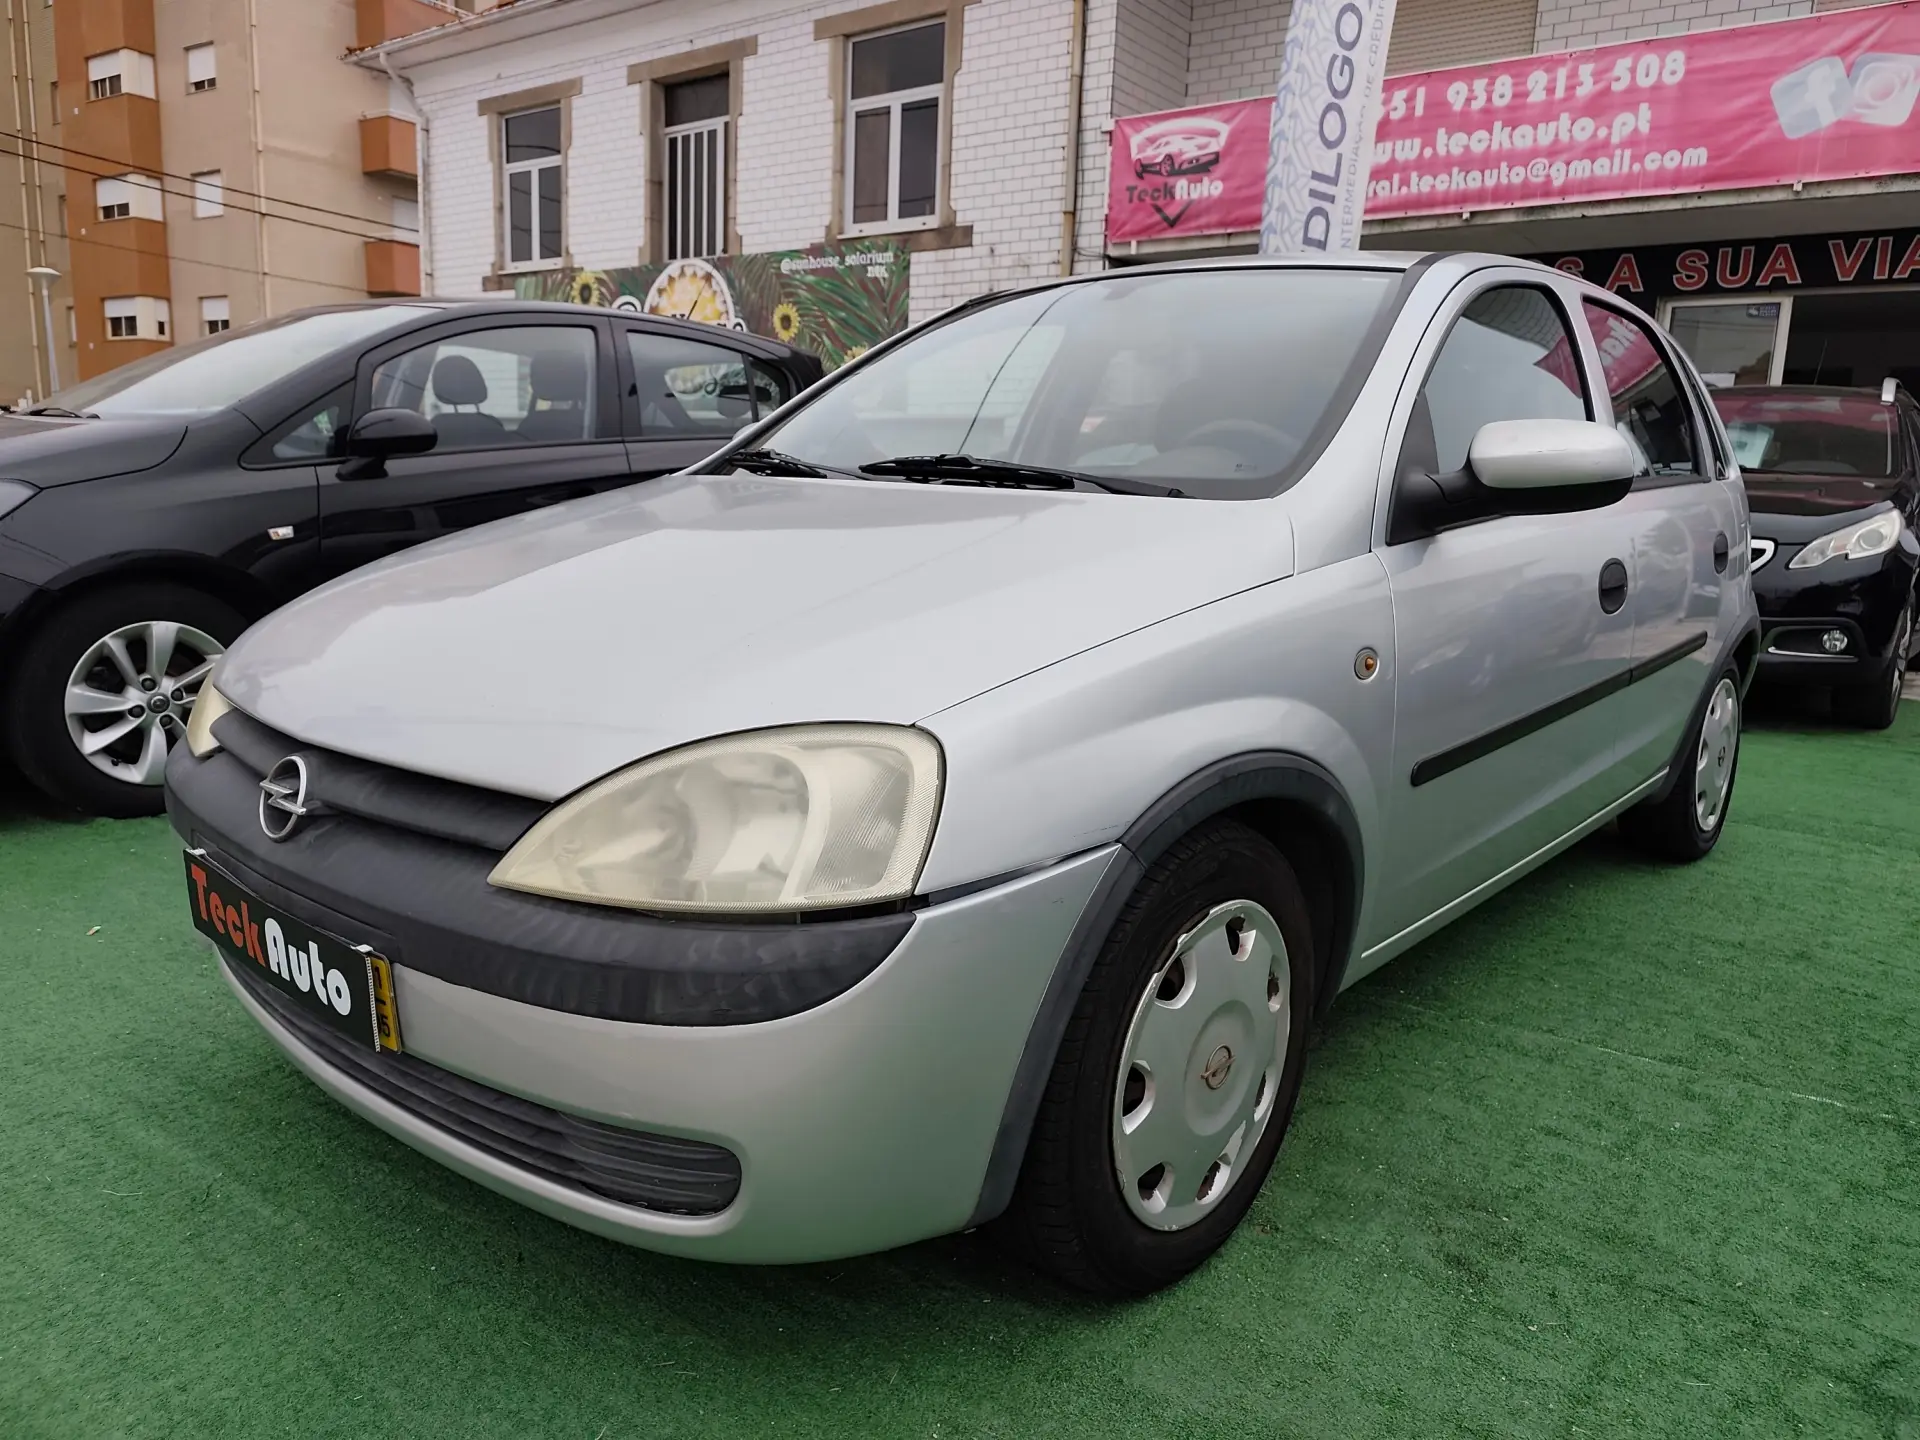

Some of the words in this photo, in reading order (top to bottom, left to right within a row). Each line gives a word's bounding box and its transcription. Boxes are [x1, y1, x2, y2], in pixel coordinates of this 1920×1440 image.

[1381, 86, 1426, 120] 51
[1446, 74, 1513, 112] 938
[1526, 63, 1595, 102] 213
[1611, 50, 1685, 92] 508
[1302, 0, 1372, 251] DILOGO
[1374, 102, 1651, 165] ww.teckauto.pt
[1126, 176, 1223, 204] TeckAuto
[1367, 147, 1708, 197] ral.teckauto@gmail.com
[1604, 253, 1644, 292] A
[1673, 243, 1802, 291] SUA
[191, 863, 351, 1016] TeckAuto
